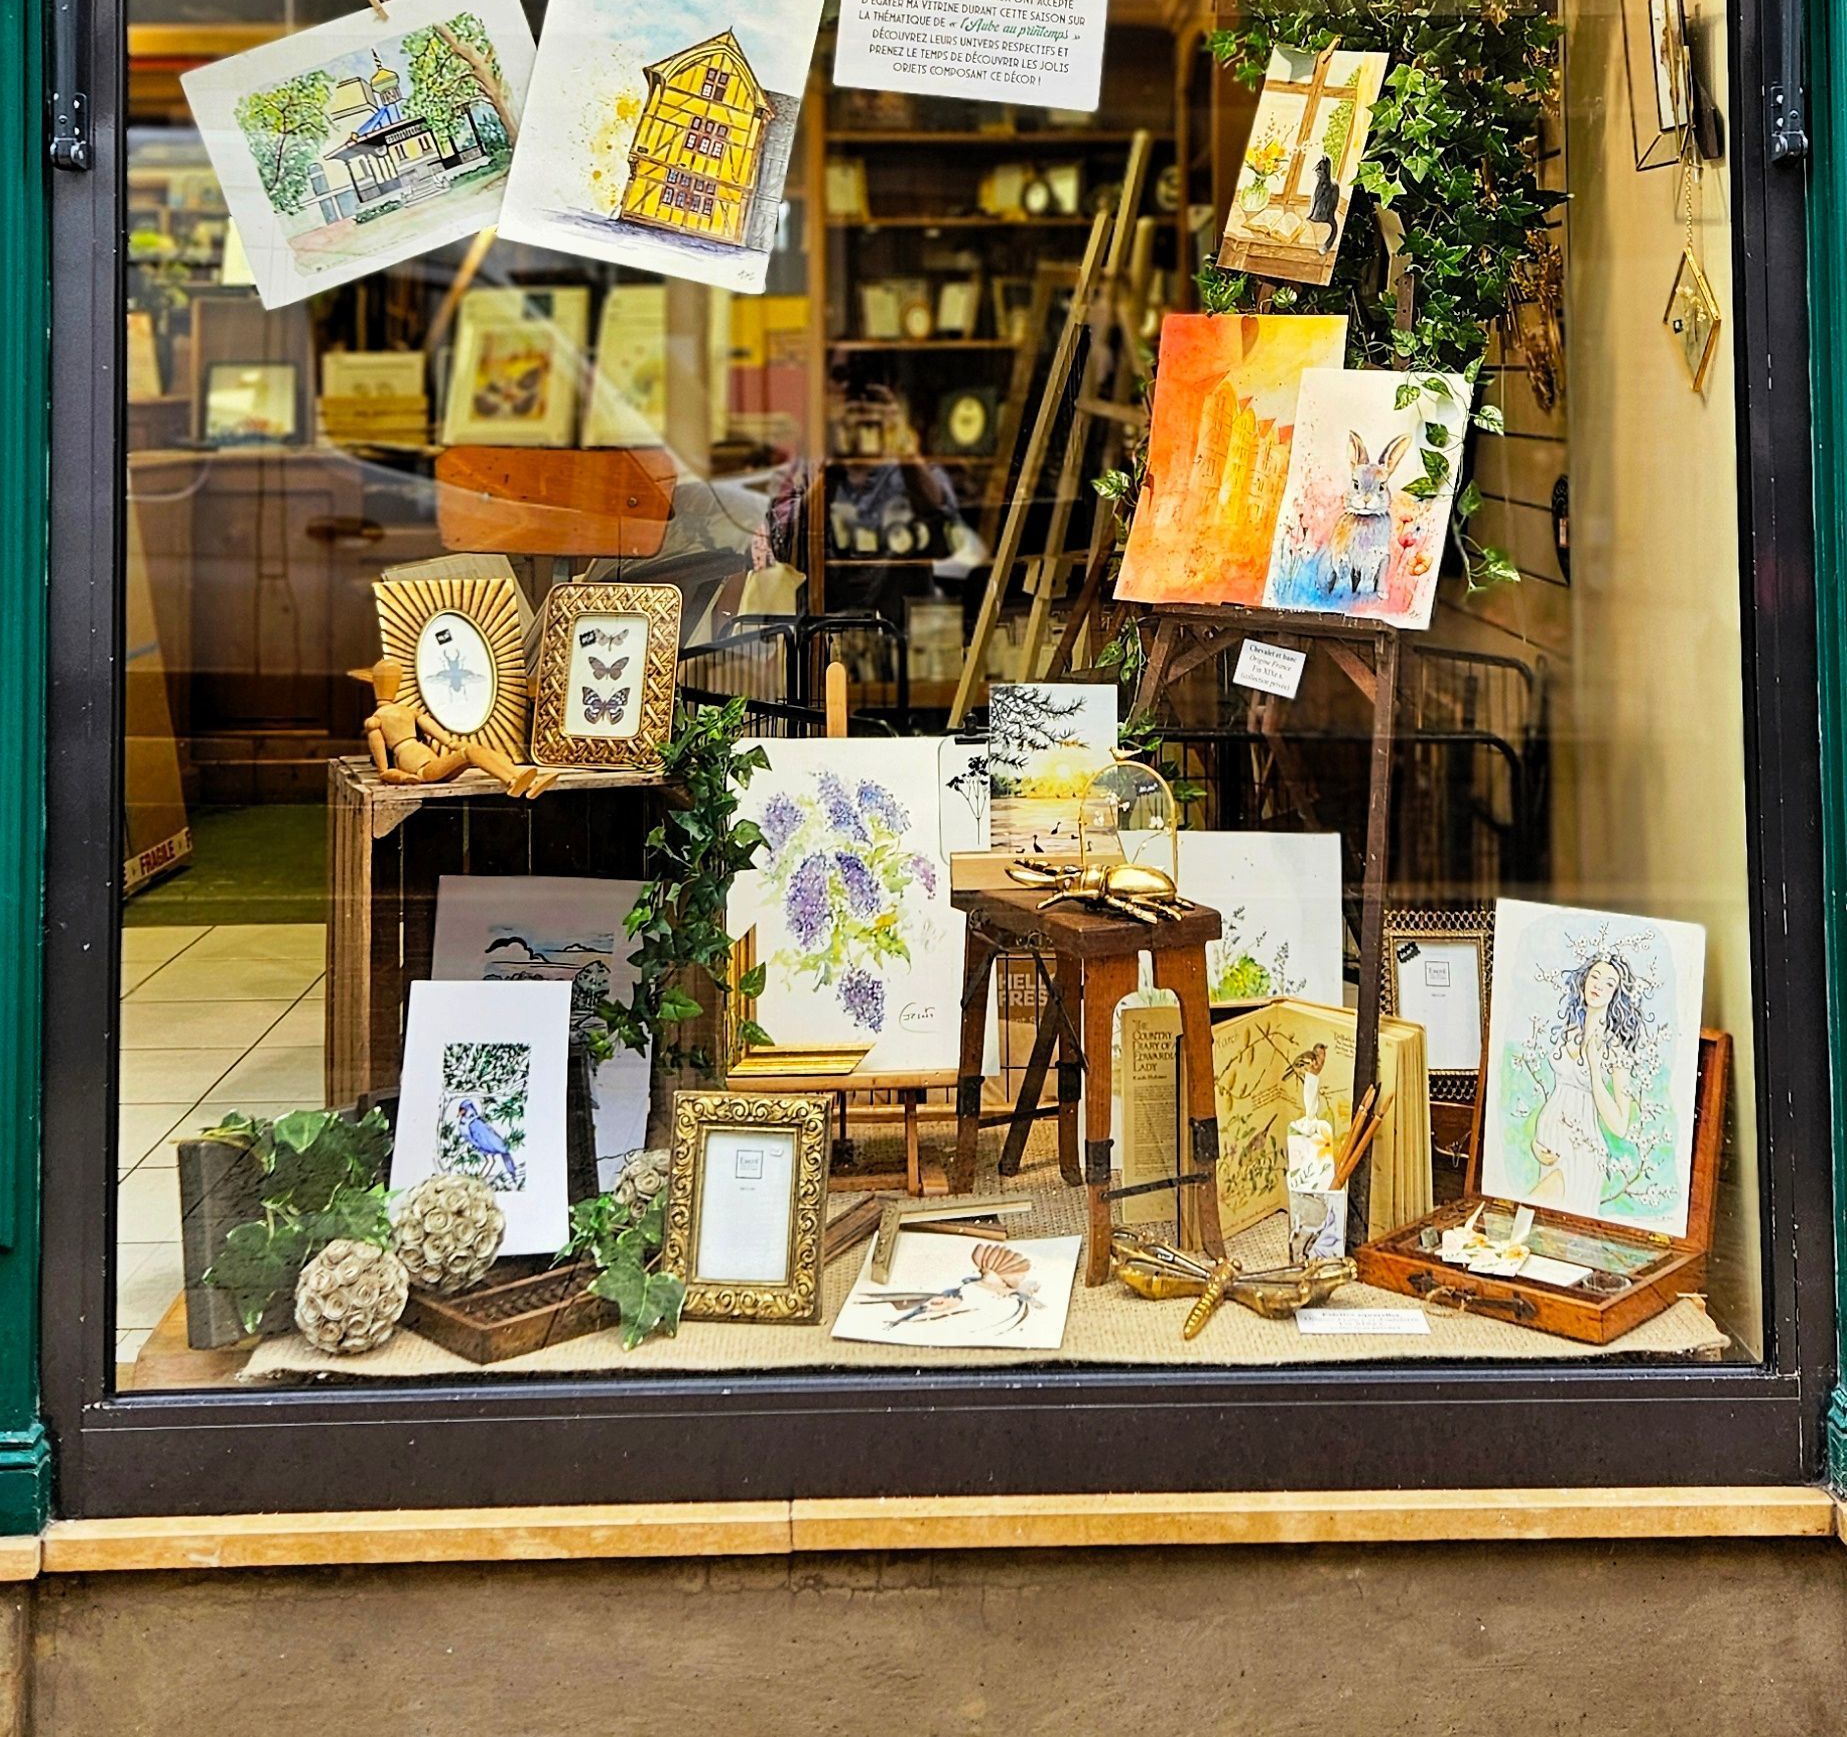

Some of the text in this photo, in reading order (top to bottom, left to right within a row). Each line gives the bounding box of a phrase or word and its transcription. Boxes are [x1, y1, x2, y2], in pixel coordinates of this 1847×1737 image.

[906, 0, 919, 9] MA
[922, 0, 959, 13] VITRINE
[961, 5, 997, 17] DURANT
[1000, 7, 1028, 20] CETTE
[1030, 11, 1066, 24] SAISON
[1068, 15, 1086, 26] SUR
[859, 9, 870, 20] LA
[873, 9, 932, 26] THÉMATIQUE
[933, 17, 946, 27] DE
[1002, 24, 1017, 34] au
[1017, 24, 1069, 42] printemps
[872, 26, 1069, 57] DÉCOUVREZ LEURS UNIVERS RESPECTIFS ET
[869, 44, 1070, 73] PRENEZ LE TEMPS DE DÉCOUVRIR LES JOLIS
[893, 62, 927, 75] OBJETS
[930, 66, 988, 80] COMPOSANT
[990, 71, 1002, 82] CE
[1004, 70, 1037, 85] DÉCOR
[1249, 645, 1274, 657] Chevalet
[140, 840, 177, 876] FRAGILE
[998, 972, 1055, 990] HELL
[1132, 1030, 1173, 1041] COUNTRY
[1133, 1063, 1158, 1072] LADY
